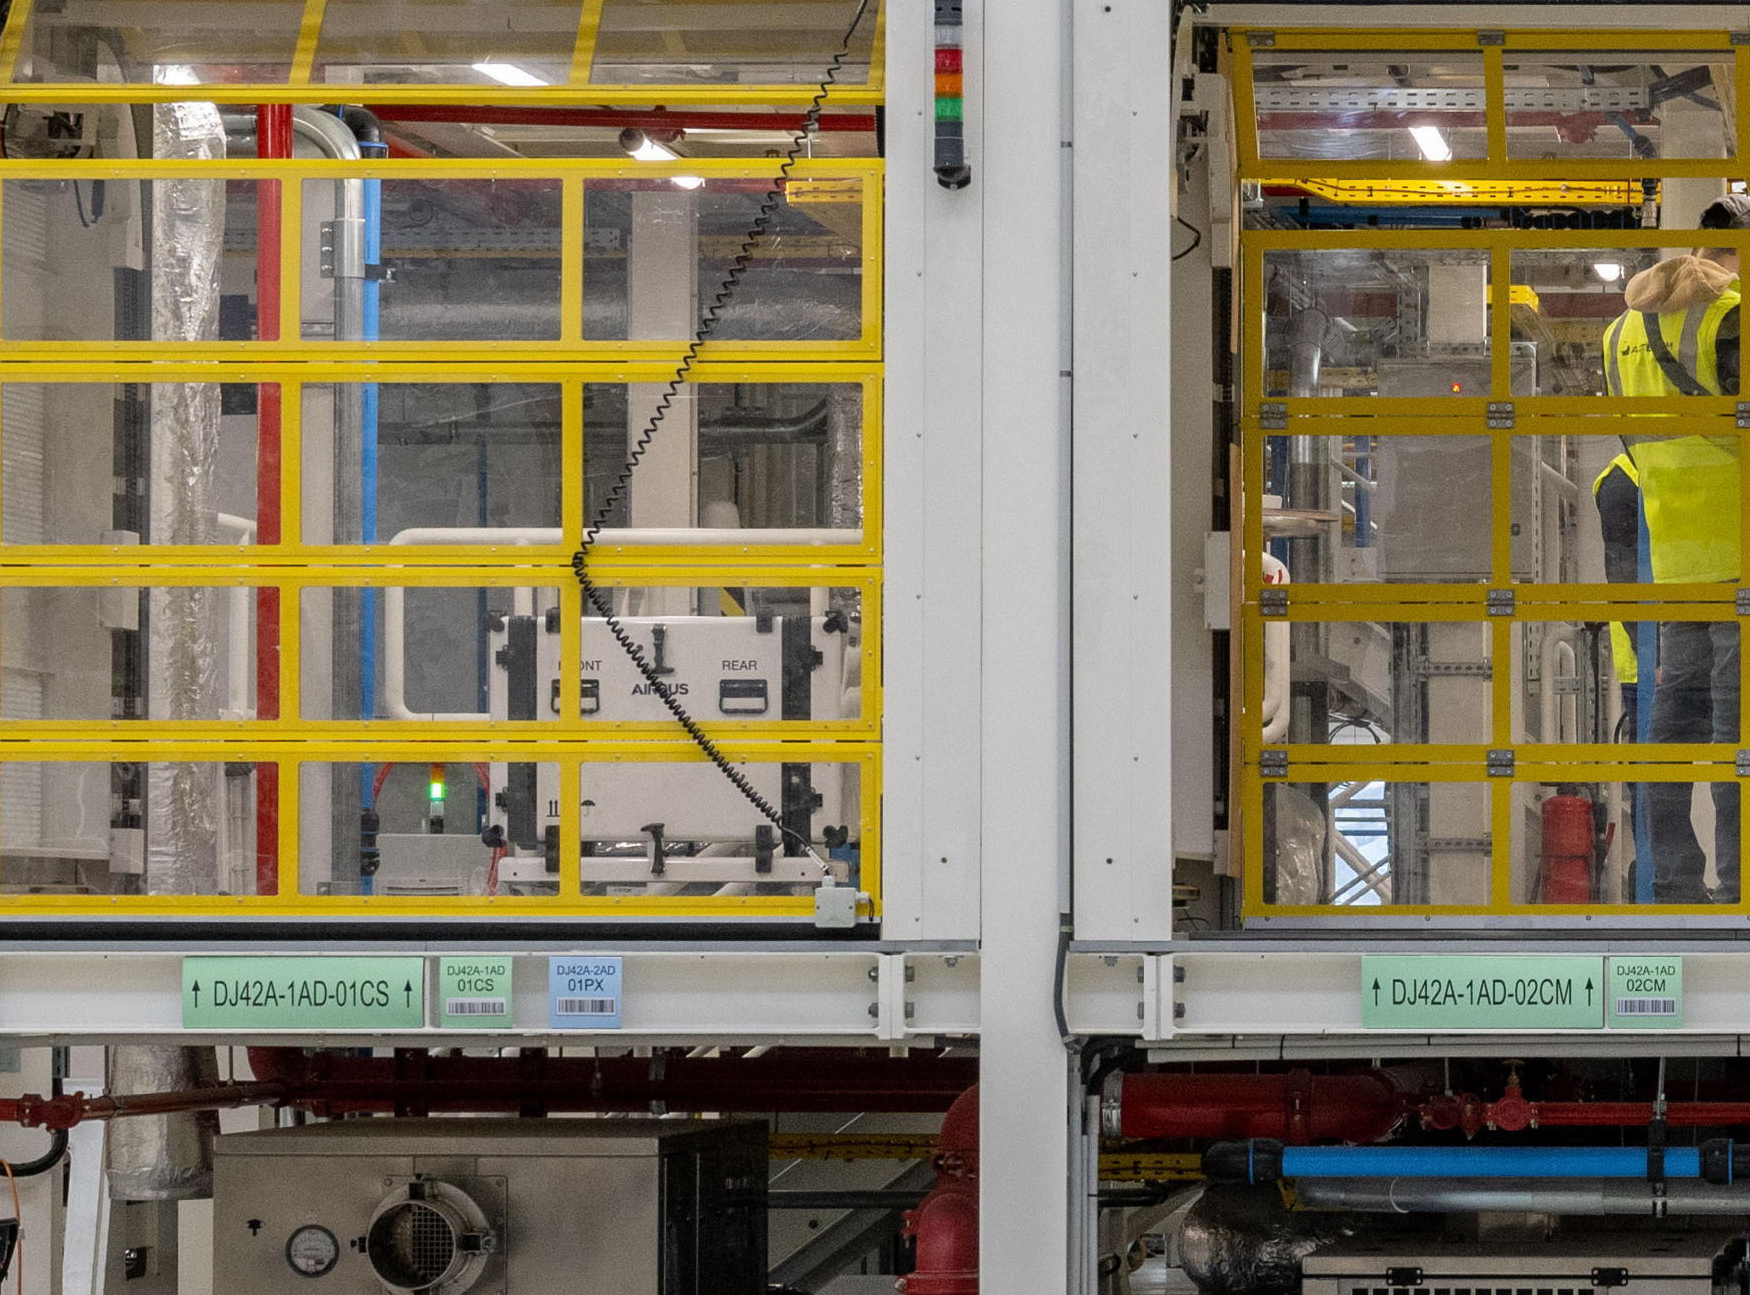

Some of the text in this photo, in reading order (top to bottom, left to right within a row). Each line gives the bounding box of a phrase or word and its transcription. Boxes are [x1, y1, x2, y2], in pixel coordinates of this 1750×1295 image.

[722, 660, 758, 671] REAR
[447, 965, 505, 976] DJ42A-1AD
[556, 965, 615, 976] DJ42A-2AD
[1617, 965, 1675, 976] DJ42A-1AD
[457, 978, 495, 992] 01CS
[567, 978, 604, 992] 01PX
[1392, 978, 1572, 1005] DJ42A-1AD-02CM
[1626, 978, 1666, 992] 02CM
[213, 980, 389, 1007] DJ42A-1AD-01CS
